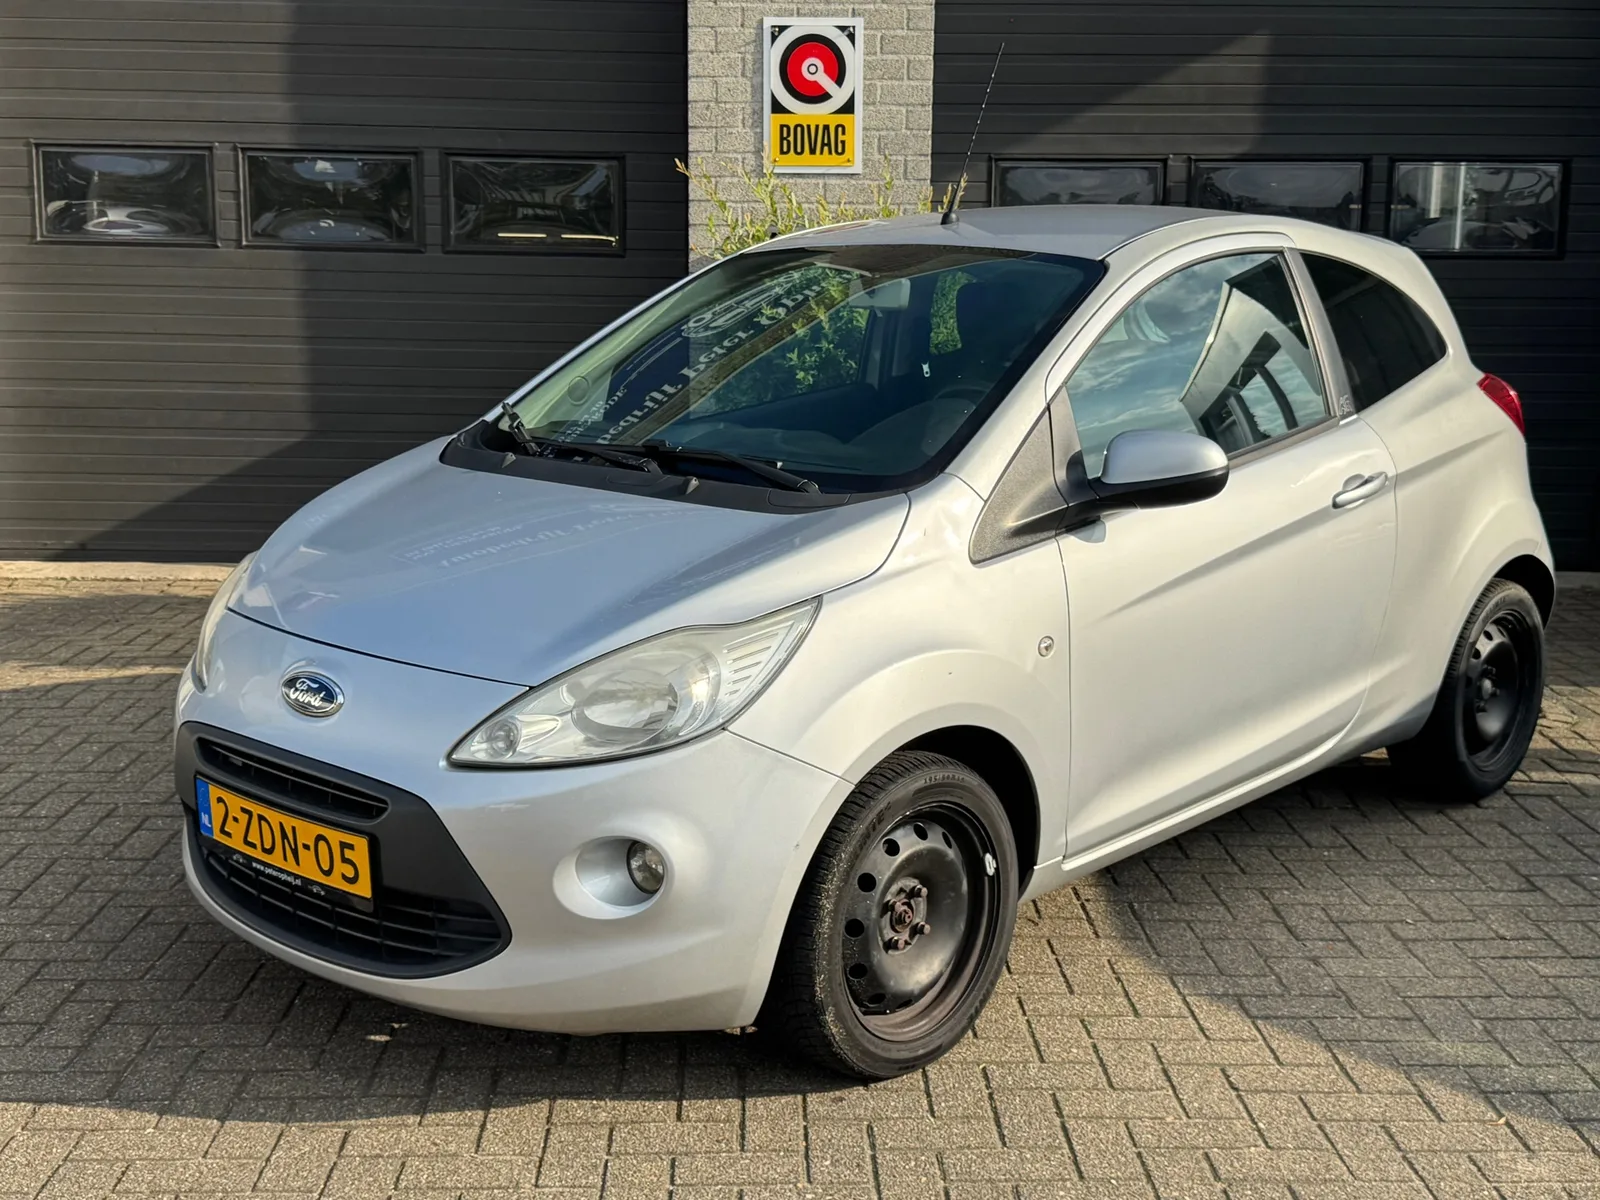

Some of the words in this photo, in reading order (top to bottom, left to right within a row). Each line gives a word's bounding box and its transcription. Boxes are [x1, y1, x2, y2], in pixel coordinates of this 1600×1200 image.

[779, 123, 846, 156] BOVAG
[288, 678, 326, 707] Ford
[201, 812, 212, 827] NL
[216, 796, 360, 885] 2-ZDN-05
